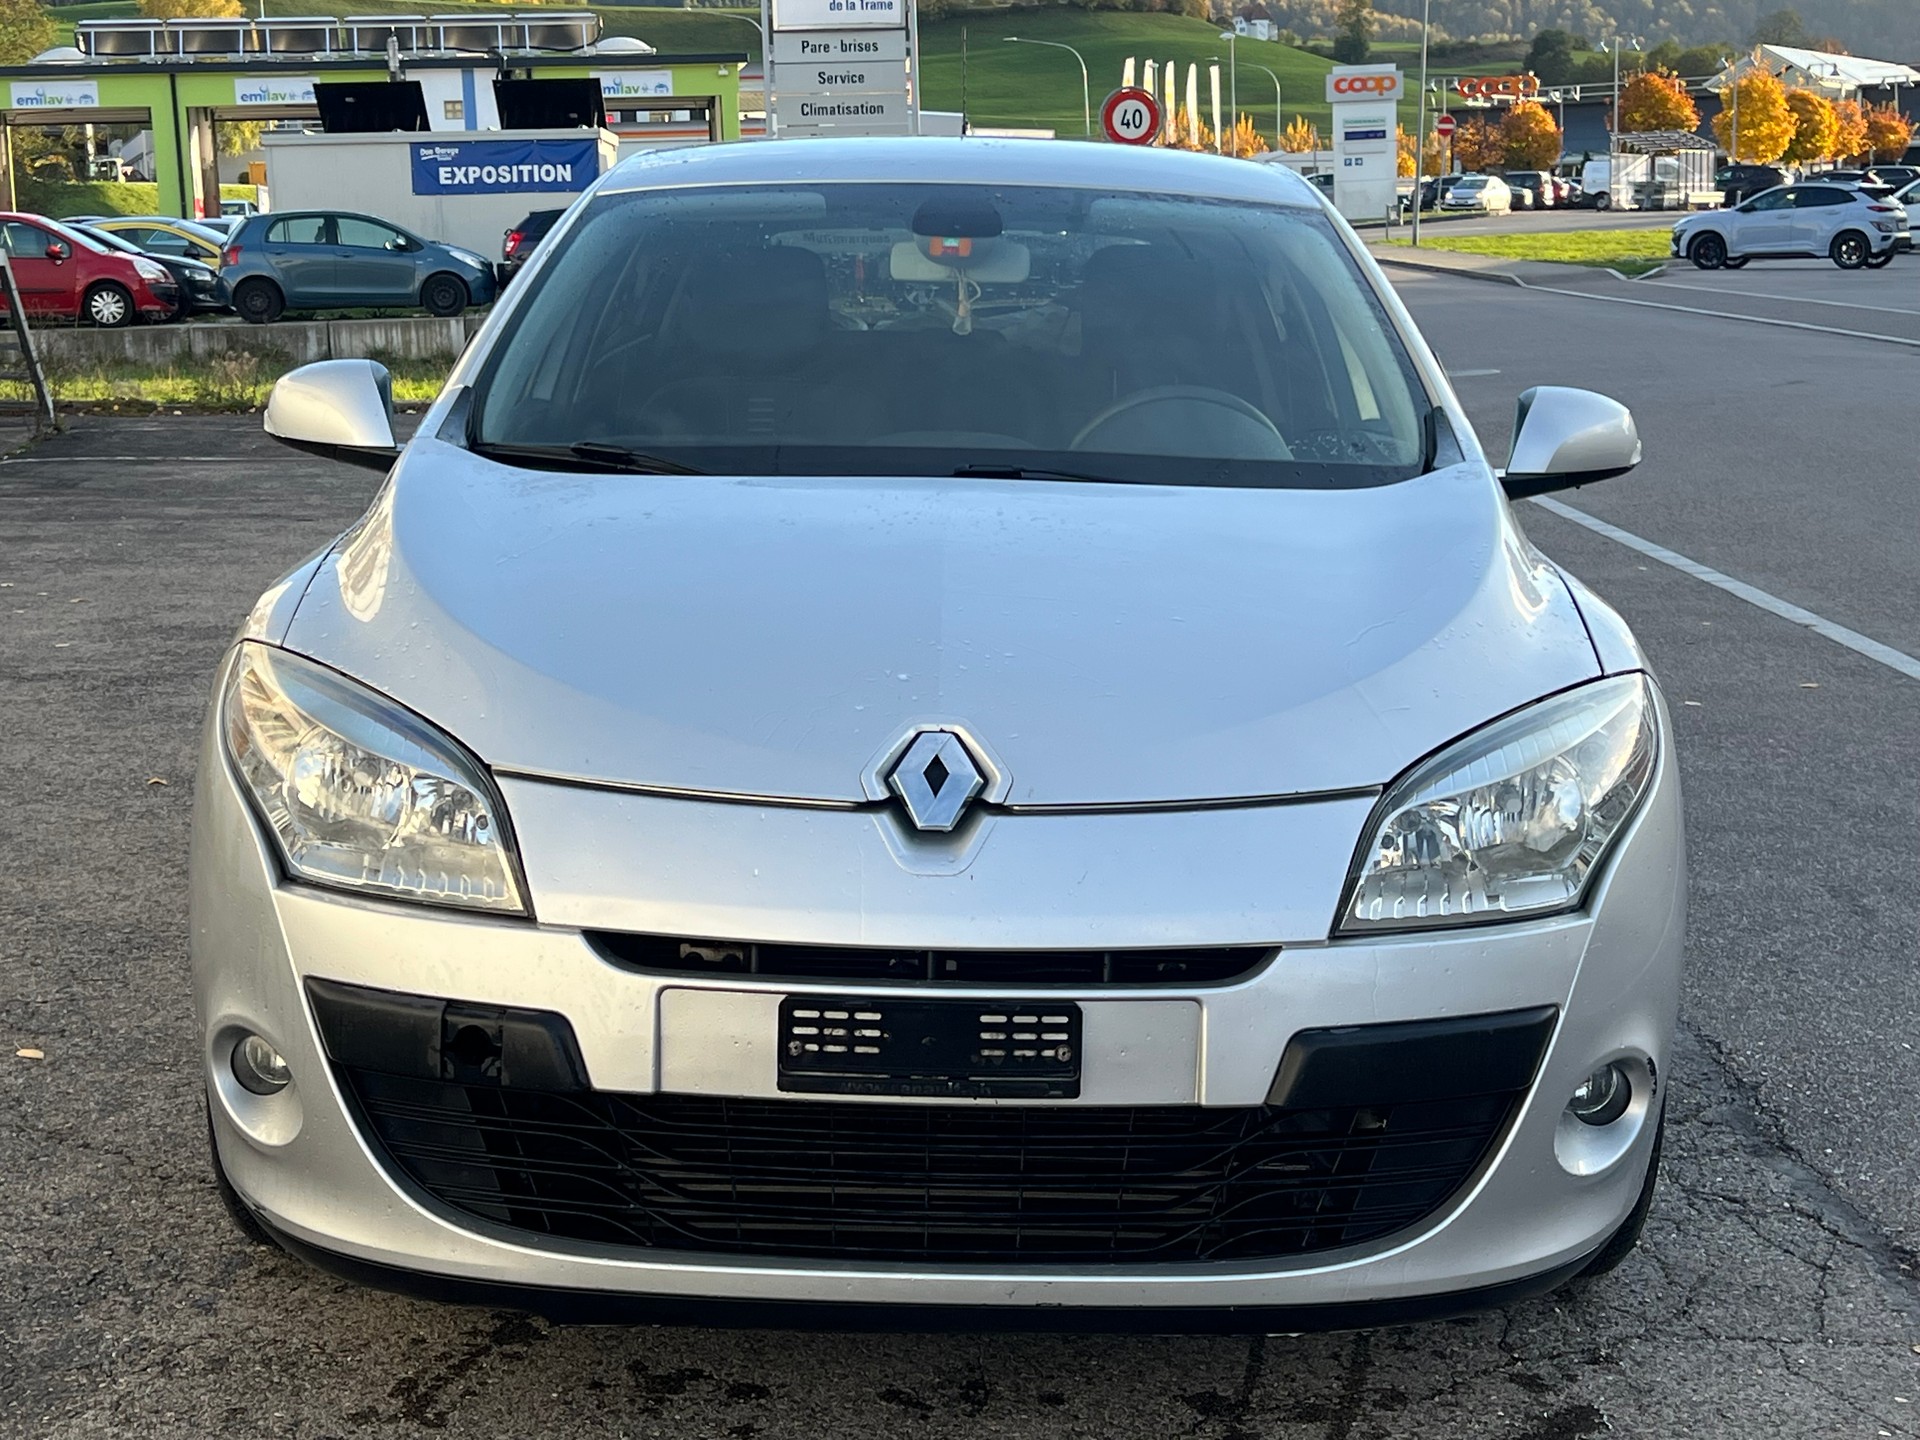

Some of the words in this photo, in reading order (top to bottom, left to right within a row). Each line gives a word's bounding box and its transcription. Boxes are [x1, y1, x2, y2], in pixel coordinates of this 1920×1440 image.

[801, 40, 830, 54] Pare
[840, 38, 879, 53] brises
[818, 70, 865, 85] Service
[240, 86, 287, 102] emilav
[1333, 76, 1397, 96] coop
[16, 90, 63, 106] emilav
[801, 101, 885, 116] Climatisation
[1121, 109, 1142, 129] 40
[438, 164, 572, 185] EXPOSITION
